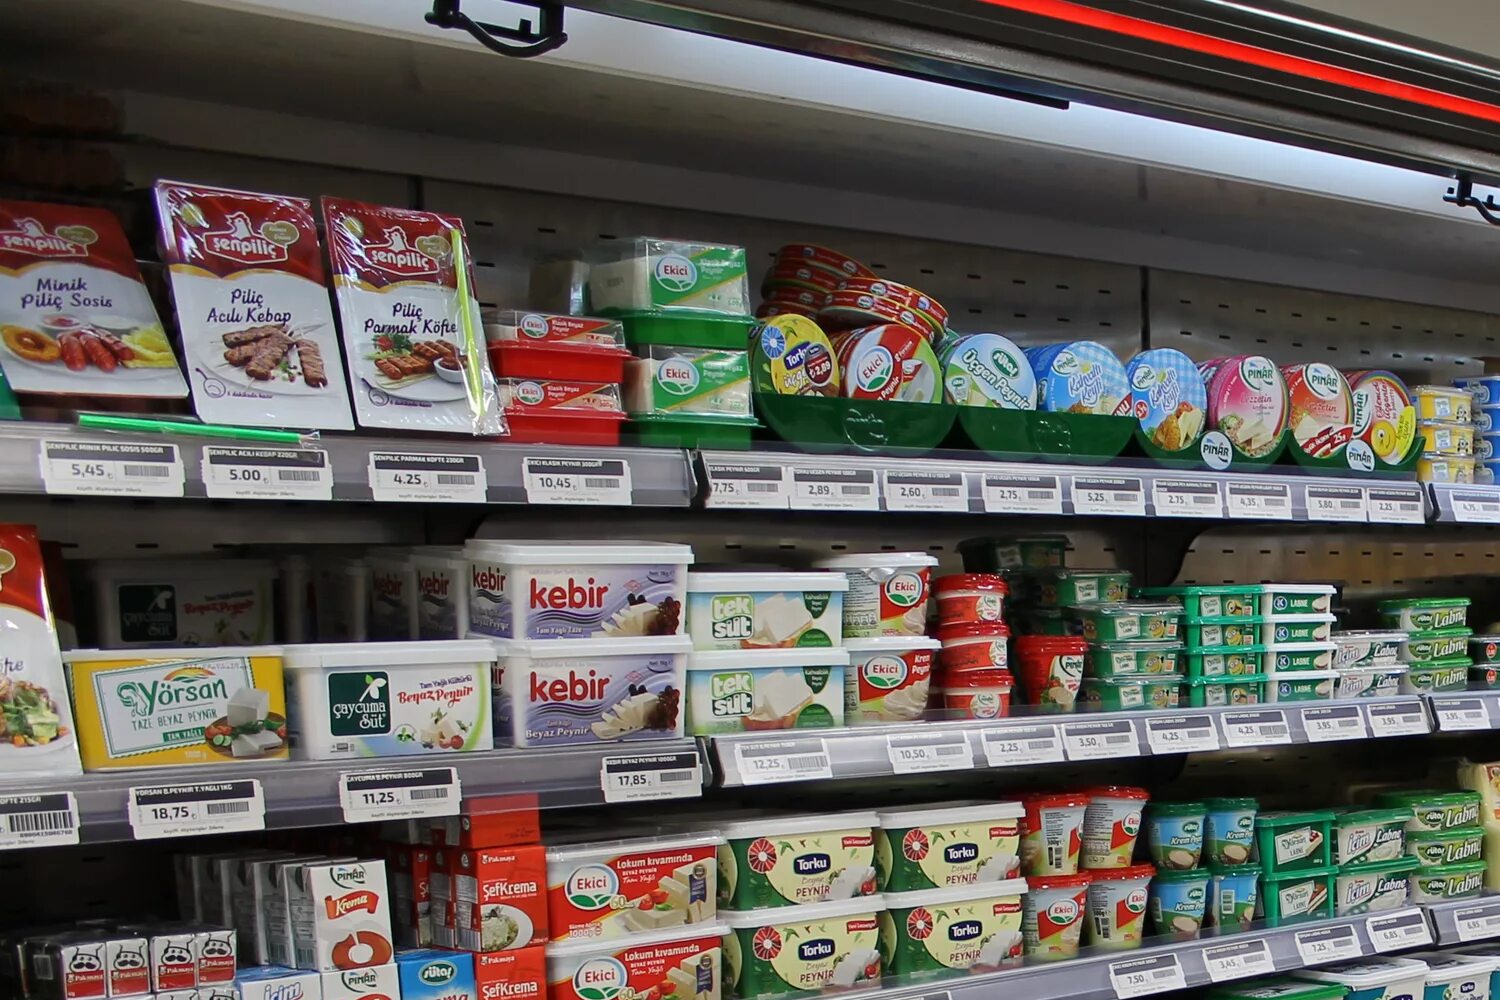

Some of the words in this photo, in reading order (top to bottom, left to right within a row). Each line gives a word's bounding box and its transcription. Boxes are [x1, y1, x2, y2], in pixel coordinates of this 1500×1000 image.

[4, 235, 76, 253] şenpiliç
[214, 238, 276, 258] şenpiliç
[371, 248, 429, 270] şenpiliç
[664, 265, 688, 277] Ekici
[36, 278, 88, 292] Minik
[21, 294, 62, 311] Piliç
[70, 294, 112, 308] Sosis
[231, 289, 263, 307] Piliç
[207, 308, 243, 323] Acılı
[246, 309, 292, 326] Kebap
[393, 303, 422, 321] Piliç
[365, 319, 417, 334] Parmak
[423, 319, 458, 335] Köfte
[963, 351, 995, 383] Üçgen
[994, 376, 1032, 411] Peynir
[1247, 367, 1274, 381] PINAR
[1203, 442, 1231, 458] PINAR
[72, 464, 104, 478] 5,45
[230, 469, 261, 481] 5.00
[394, 474, 421, 485] 4.25
[539, 477, 570, 489] 10,45
[808, 485, 830, 496] 2,89
[900, 487, 921, 498] 2,60
[472, 565, 506, 592] kebir
[530, 577, 607, 609] kebir
[895, 581, 917, 592] Ekici
[713, 597, 751, 617] tek
[713, 619, 752, 638] süt
[872, 664, 899, 675] Ekici
[530, 670, 607, 703] kebir
[137, 678, 228, 717] Yörsan
[333, 702, 386, 719] çaycuma
[131, 720, 153, 731] TAZE
[158, 714, 182, 728] BEYAZ
[185, 708, 217, 725] PEYNİR
[359, 712, 385, 729] Süt
[526, 728, 555, 740] Beyaz
[557, 726, 590, 740] Peynir
[1000, 743, 1019, 753] 2,25
[1079, 737, 1097, 747] 3,50
[900, 749, 925, 760] 10,50
[753, 759, 780, 770] 12,25
[618, 774, 647, 786] 17,85
[362, 792, 395, 805] 11,25
[152, 808, 189, 820] 18,75
[948, 846, 975, 860] Torku
[617, 857, 645, 869] Lokum
[647, 853, 693, 867] kıvamında
[797, 857, 828, 872] Torku
[336, 870, 366, 882] PINAR
[576, 876, 608, 890] Ekici
[946, 873, 978, 885] PEYNİR
[482, 880, 537, 899] ŞefKrema
[336, 894, 369, 914] Krema
[952, 924, 980, 939] Torku
[625, 950, 653, 961] Lokum
[654, 944, 700, 959] kıvamında
[802, 942, 831, 957] Torku
[348, 972, 377, 985] PINAR
[422, 964, 453, 982] sütaş
[584, 969, 616, 983] Ekici
[800, 970, 834, 984] PEYNİR
[482, 980, 538, 999] ŞefKrema
